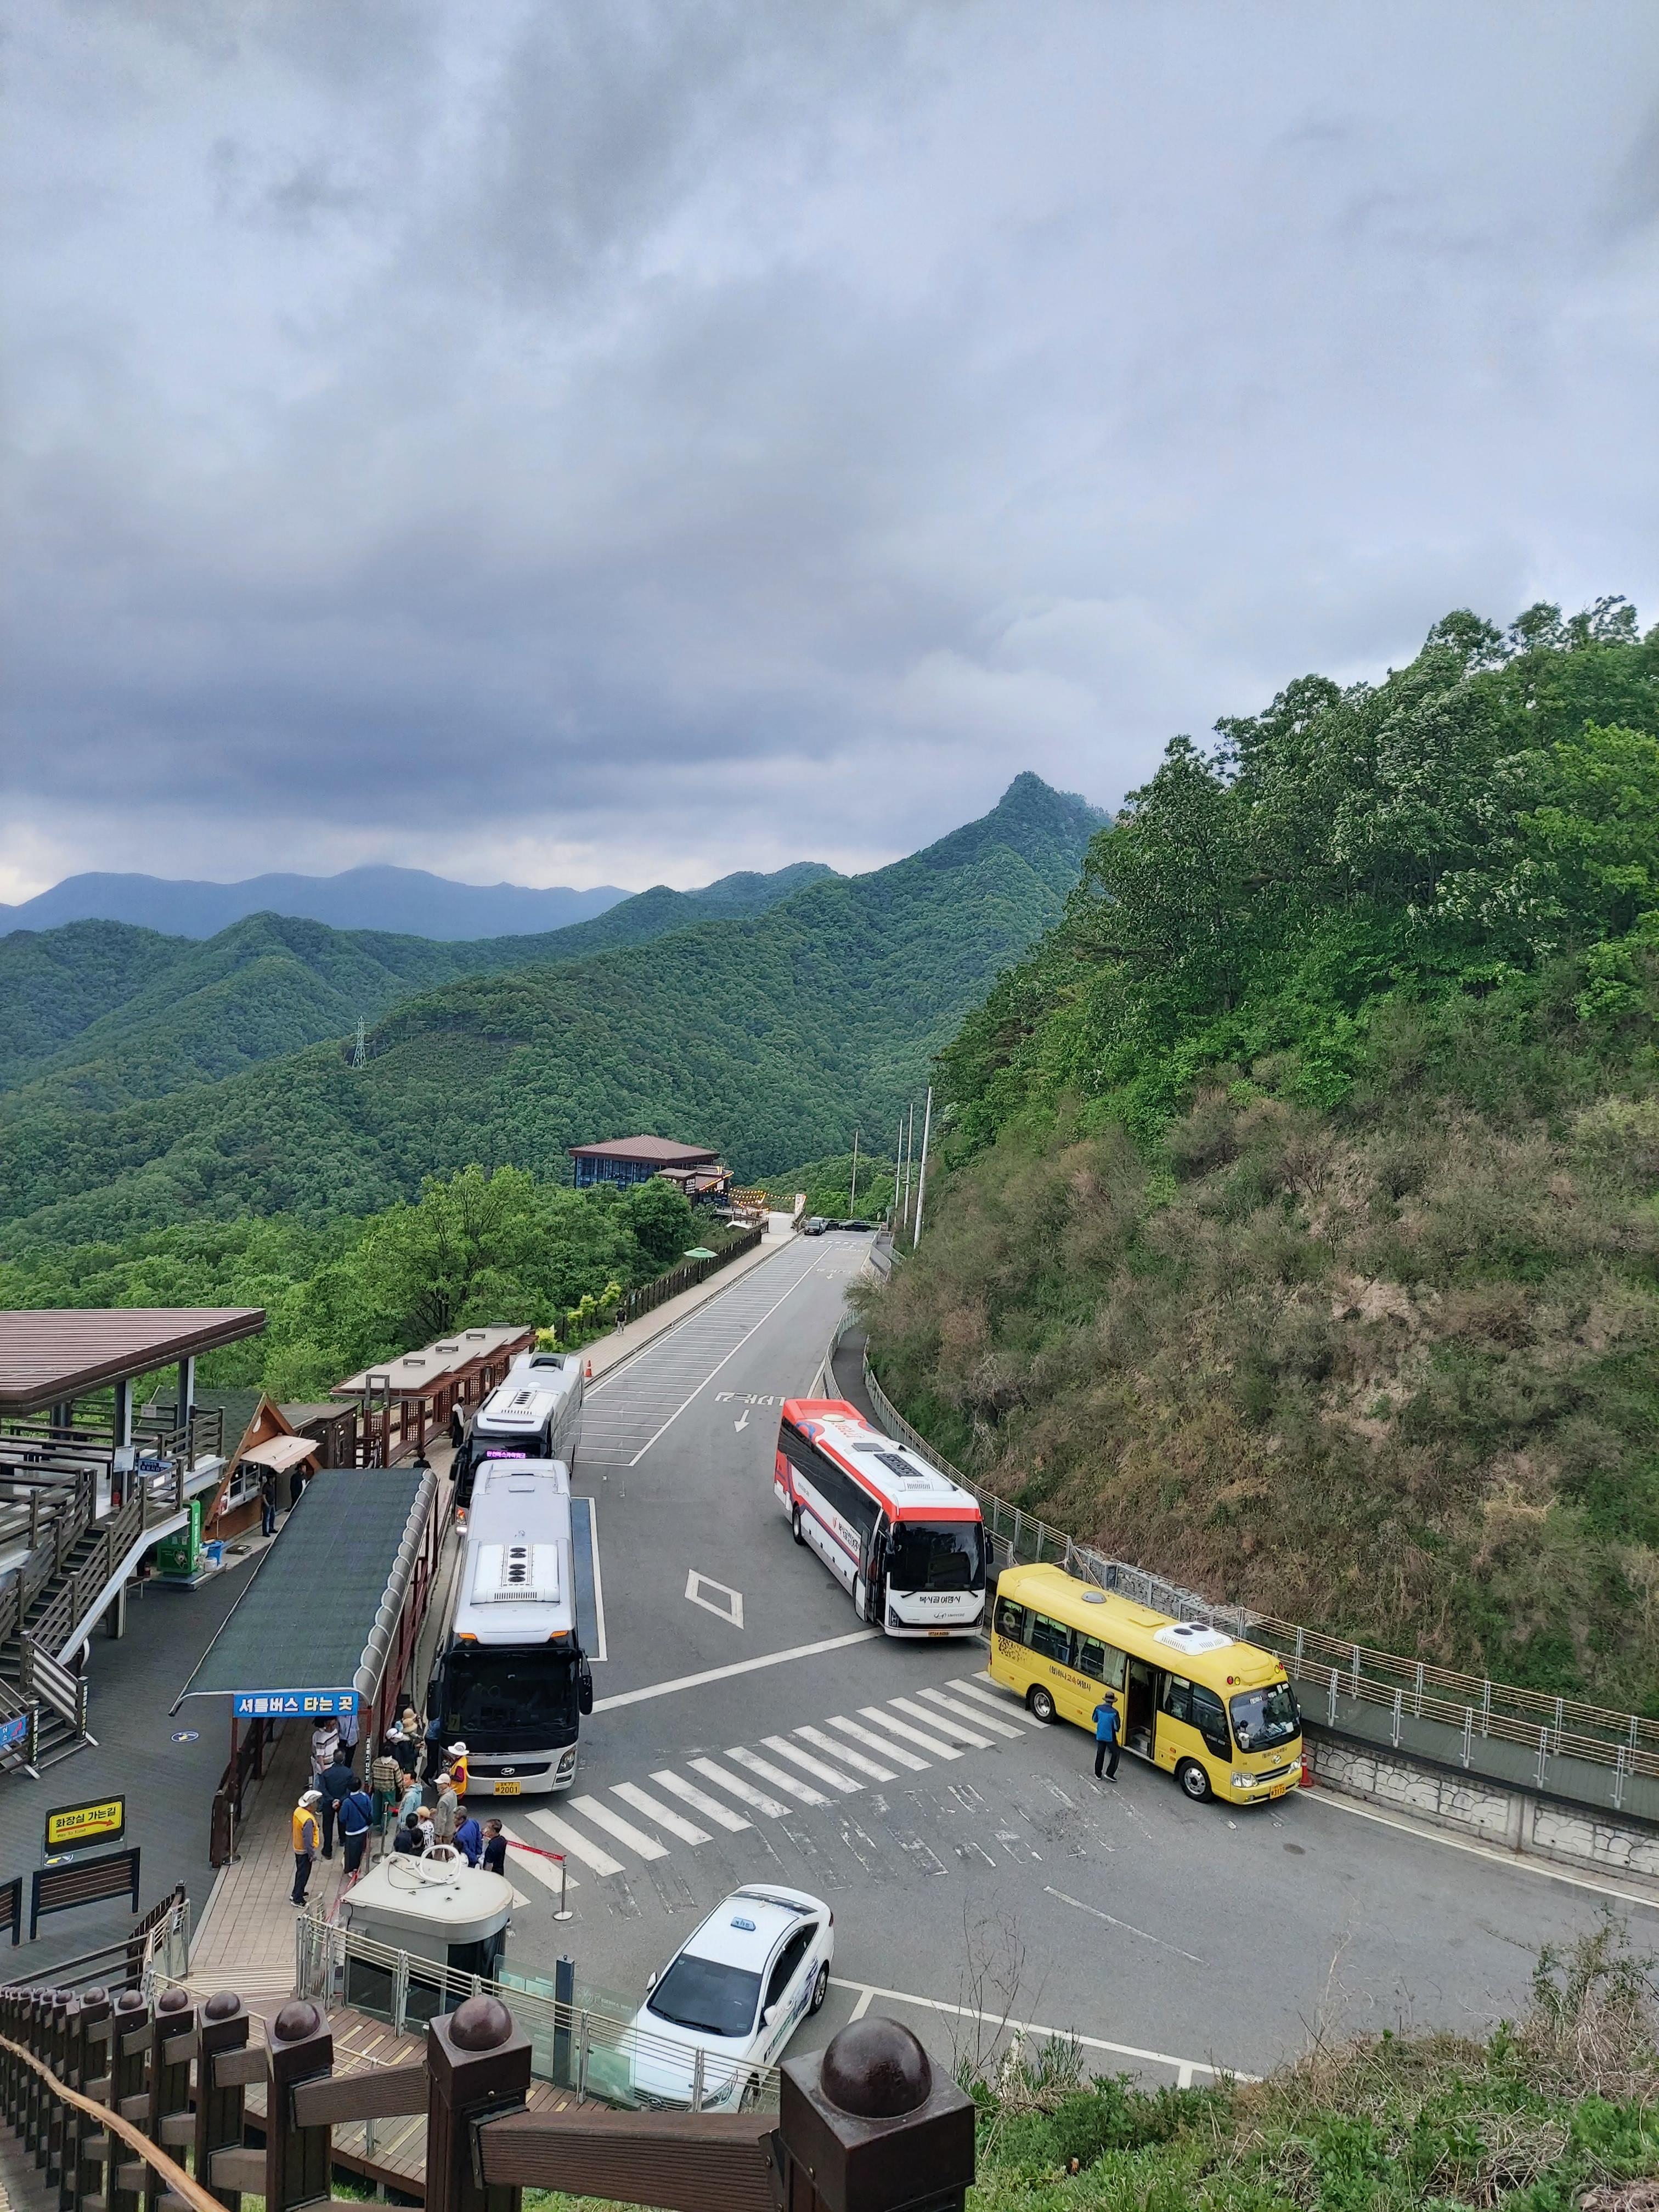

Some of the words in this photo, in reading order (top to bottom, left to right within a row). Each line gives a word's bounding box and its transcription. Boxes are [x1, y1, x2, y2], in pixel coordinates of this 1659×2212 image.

[714, 1391, 786, 1406] 나가는길
[238, 1697, 299, 1713] 셔틀버스
[303, 1696, 334, 1712] 타는
[338, 1695, 353, 1711] 곳
[56, 1814, 84, 1827] 화장실
[88, 1806, 116, 1821] 가는길
